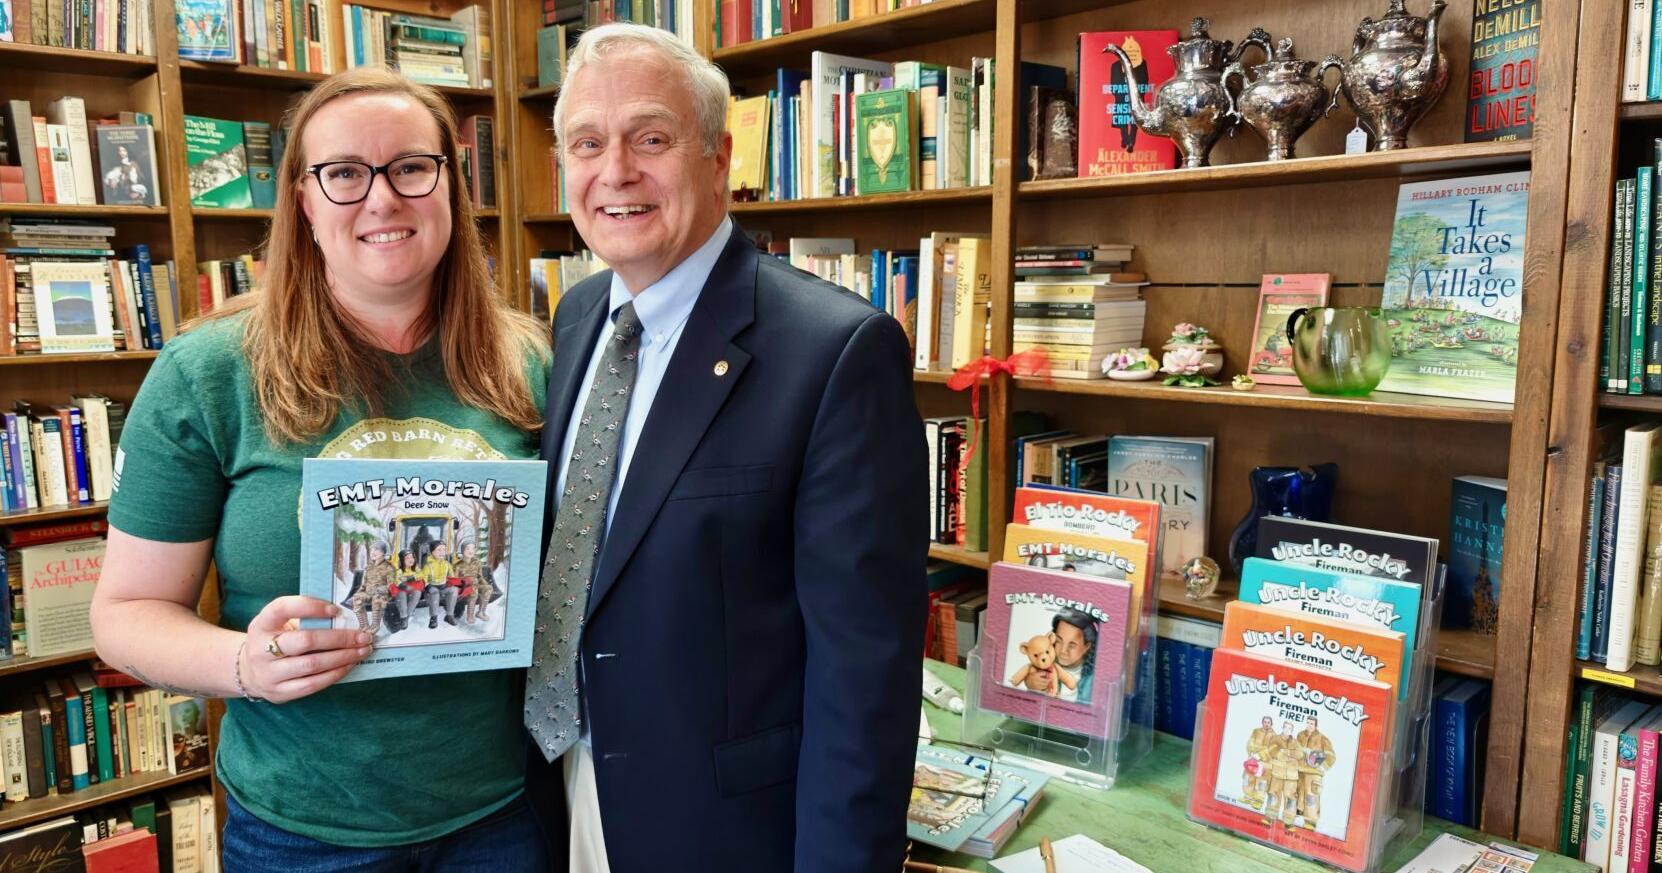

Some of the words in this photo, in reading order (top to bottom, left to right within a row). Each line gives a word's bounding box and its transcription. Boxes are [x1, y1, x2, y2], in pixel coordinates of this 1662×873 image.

[1473, 44, 1499, 59] ALEX
[1103, 84, 1154, 94] DEPARENT
[1472, 59, 1537, 99] BLOO
[1113, 114, 1136, 125] CRIM
[1097, 148, 1157, 162] ALEXANDER
[1412, 189, 1453, 201] HILLARY
[1456, 184, 1502, 196] RODHAM
[1465, 199, 1488, 228] It
[1437, 225, 1512, 255] Takes
[1479, 256, 1492, 276] a
[1613, 240, 1622, 285] LANDSCAPING
[1623, 239, 1632, 285] LANDSCAPING
[1422, 268, 1516, 307] Village
[1622, 286, 1631, 317] PROJECTS
[1419, 365, 1448, 376] MARLA
[351, 431, 387, 451] RED
[392, 428, 446, 444] BARN
[452, 438, 488, 459] RET
[317, 478, 385, 511] EMT
[395, 477, 530, 509] Morales
[404, 501, 425, 510] Deep
[427, 501, 450, 509] Snow
[1112, 479, 1197, 506] PARIS
[1025, 501, 1042, 520] El
[1079, 504, 1142, 534] Rocky
[1455, 515, 1505, 537] KRISTI
[1017, 542, 1054, 557] EMT
[1060, 543, 1136, 574] Morales
[1271, 538, 1334, 561] Uncle
[1337, 542, 1412, 580] Rocky
[1315, 559, 1363, 575] Fireman
[31, 571, 100, 590] Archipelag
[1005, 592, 1038, 605] EMT
[1041, 593, 1111, 623] Morales
[1258, 581, 1320, 604] Uncle
[1326, 586, 1401, 627] Rocky
[1300, 601, 1350, 620] Fireman
[1242, 625, 1307, 649] Uncle
[1310, 630, 1387, 676] Rocky
[1284, 647, 1333, 667] Fireman
[1225, 674, 1289, 697] Uncle
[1292, 682, 1369, 727] Rocky
[1269, 695, 1318, 717] Fireman
[1278, 709, 1305, 722] FIRE!
[1642, 739, 1655, 756] The
[1575, 774, 1584, 798] FRUITS
[1637, 758, 1654, 790] Family
[1573, 799, 1583, 814] AND
[1618, 777, 1631, 814] Lasagna
[1637, 790, 1650, 827] Kitchen
[1570, 814, 1580, 844] BERRIES
[1593, 802, 1606, 828] GROW
[1614, 815, 1628, 856] Gardening
[1633, 828, 1648, 863] Garden
